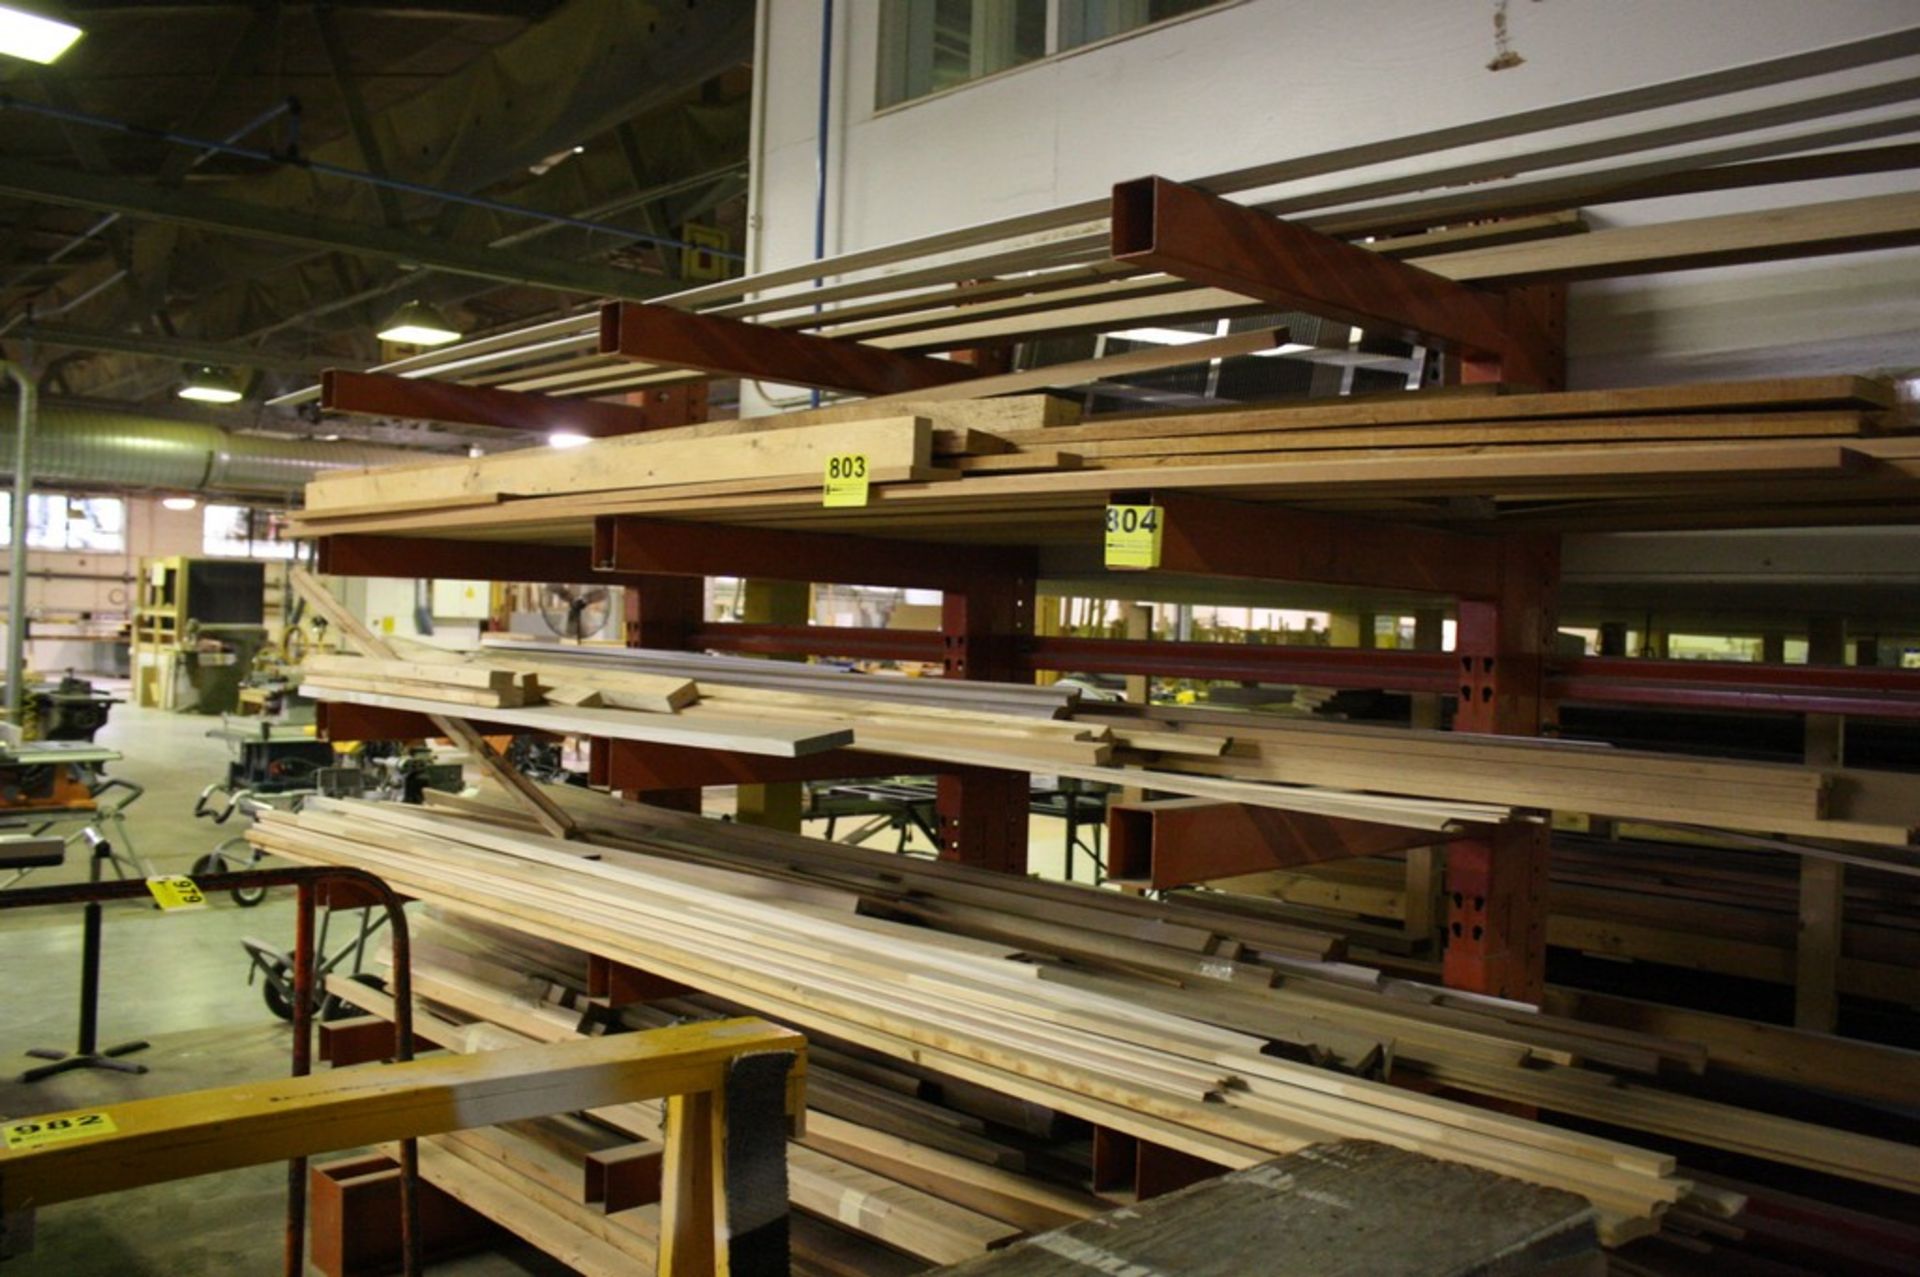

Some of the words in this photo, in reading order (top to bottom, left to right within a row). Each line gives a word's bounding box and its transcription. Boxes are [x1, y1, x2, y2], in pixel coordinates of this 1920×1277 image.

[829, 456, 865, 479] 803
[1106, 508, 1158, 533] 804
[172, 880, 202, 903] 979
[13, 1115, 104, 1135] 982
